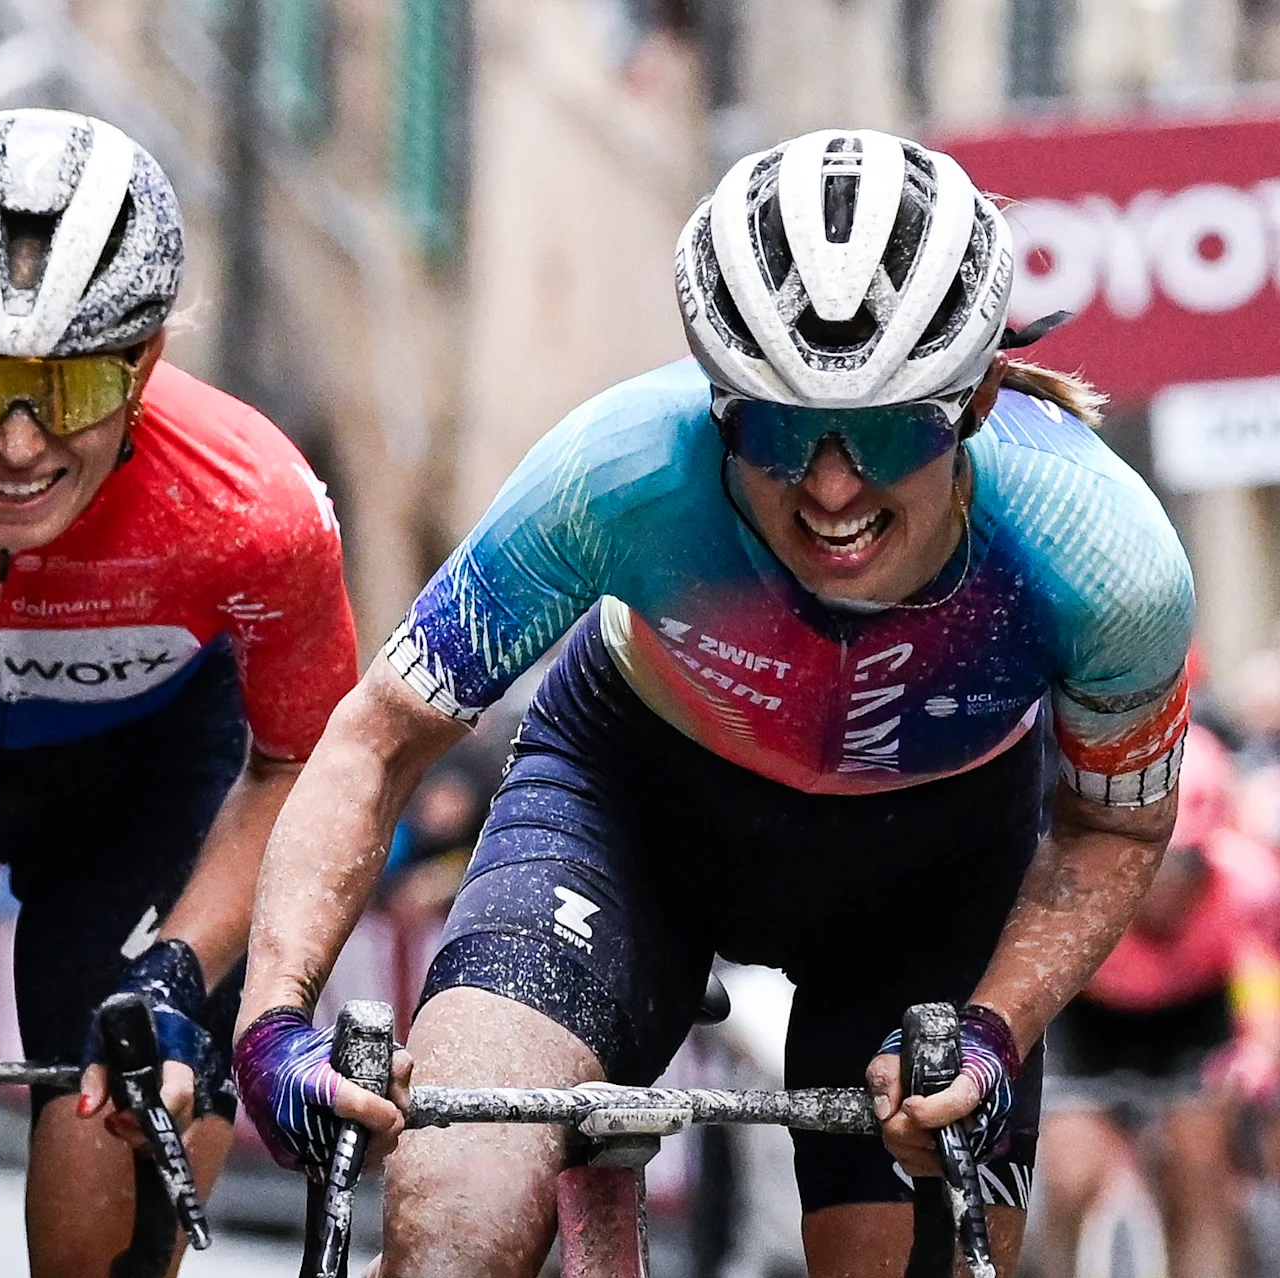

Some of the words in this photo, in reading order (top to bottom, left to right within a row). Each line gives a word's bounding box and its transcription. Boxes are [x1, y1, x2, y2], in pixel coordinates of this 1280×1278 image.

[698, 634, 791, 680] ZWIFT
[671, 650, 783, 711] RAM
[966, 693, 992, 702] UCI
[553, 922, 594, 955] ZWIFT
